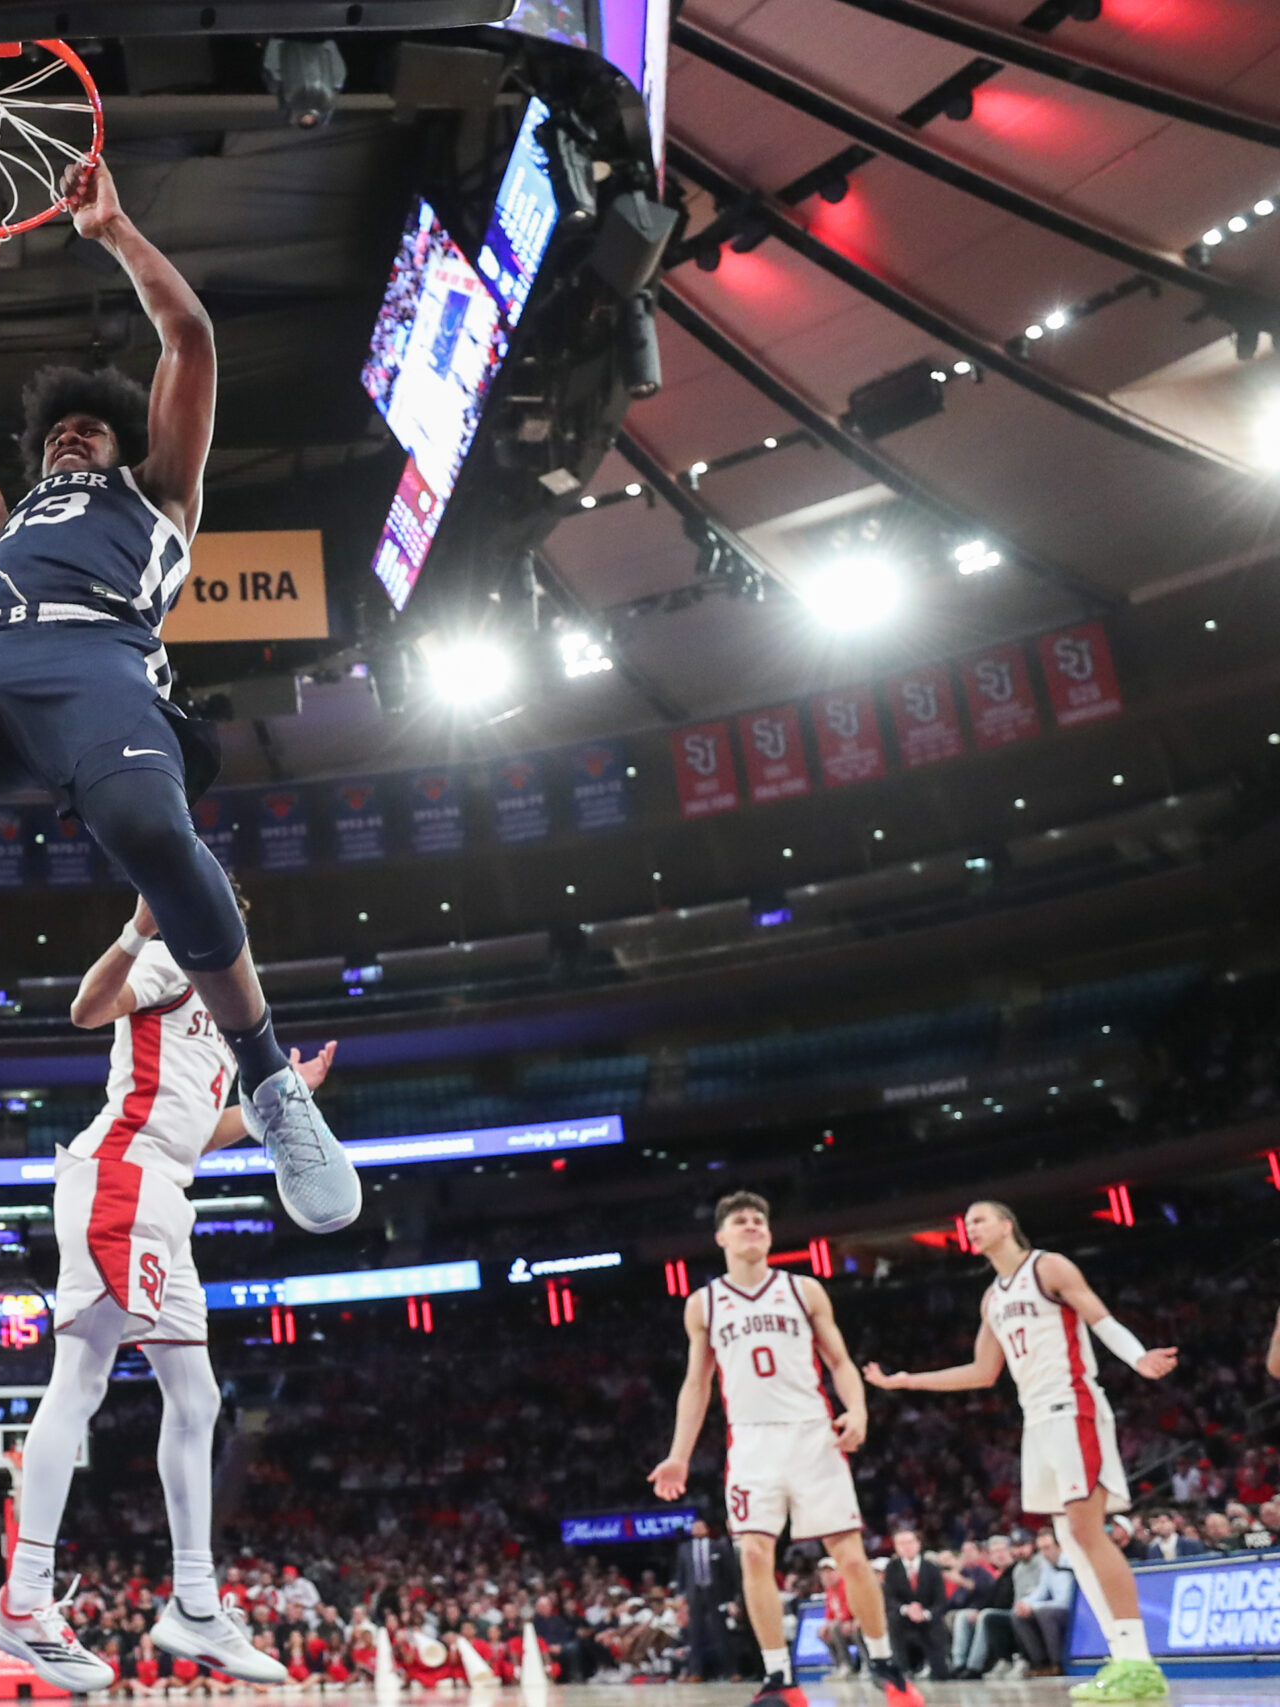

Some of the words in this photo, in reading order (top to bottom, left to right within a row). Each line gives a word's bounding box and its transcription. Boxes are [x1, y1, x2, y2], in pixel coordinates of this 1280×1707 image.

[193, 576, 228, 602] to
[239, 570, 298, 601] IRA
[8, 604, 28, 623] B
[187, 1010, 213, 1037] ST.
[719, 1322, 740, 1348] ST.
[742, 1314, 800, 1338] JOHN'S
[1007, 1326, 1028, 1359] 17
[751, 1346, 776, 1378] 0
